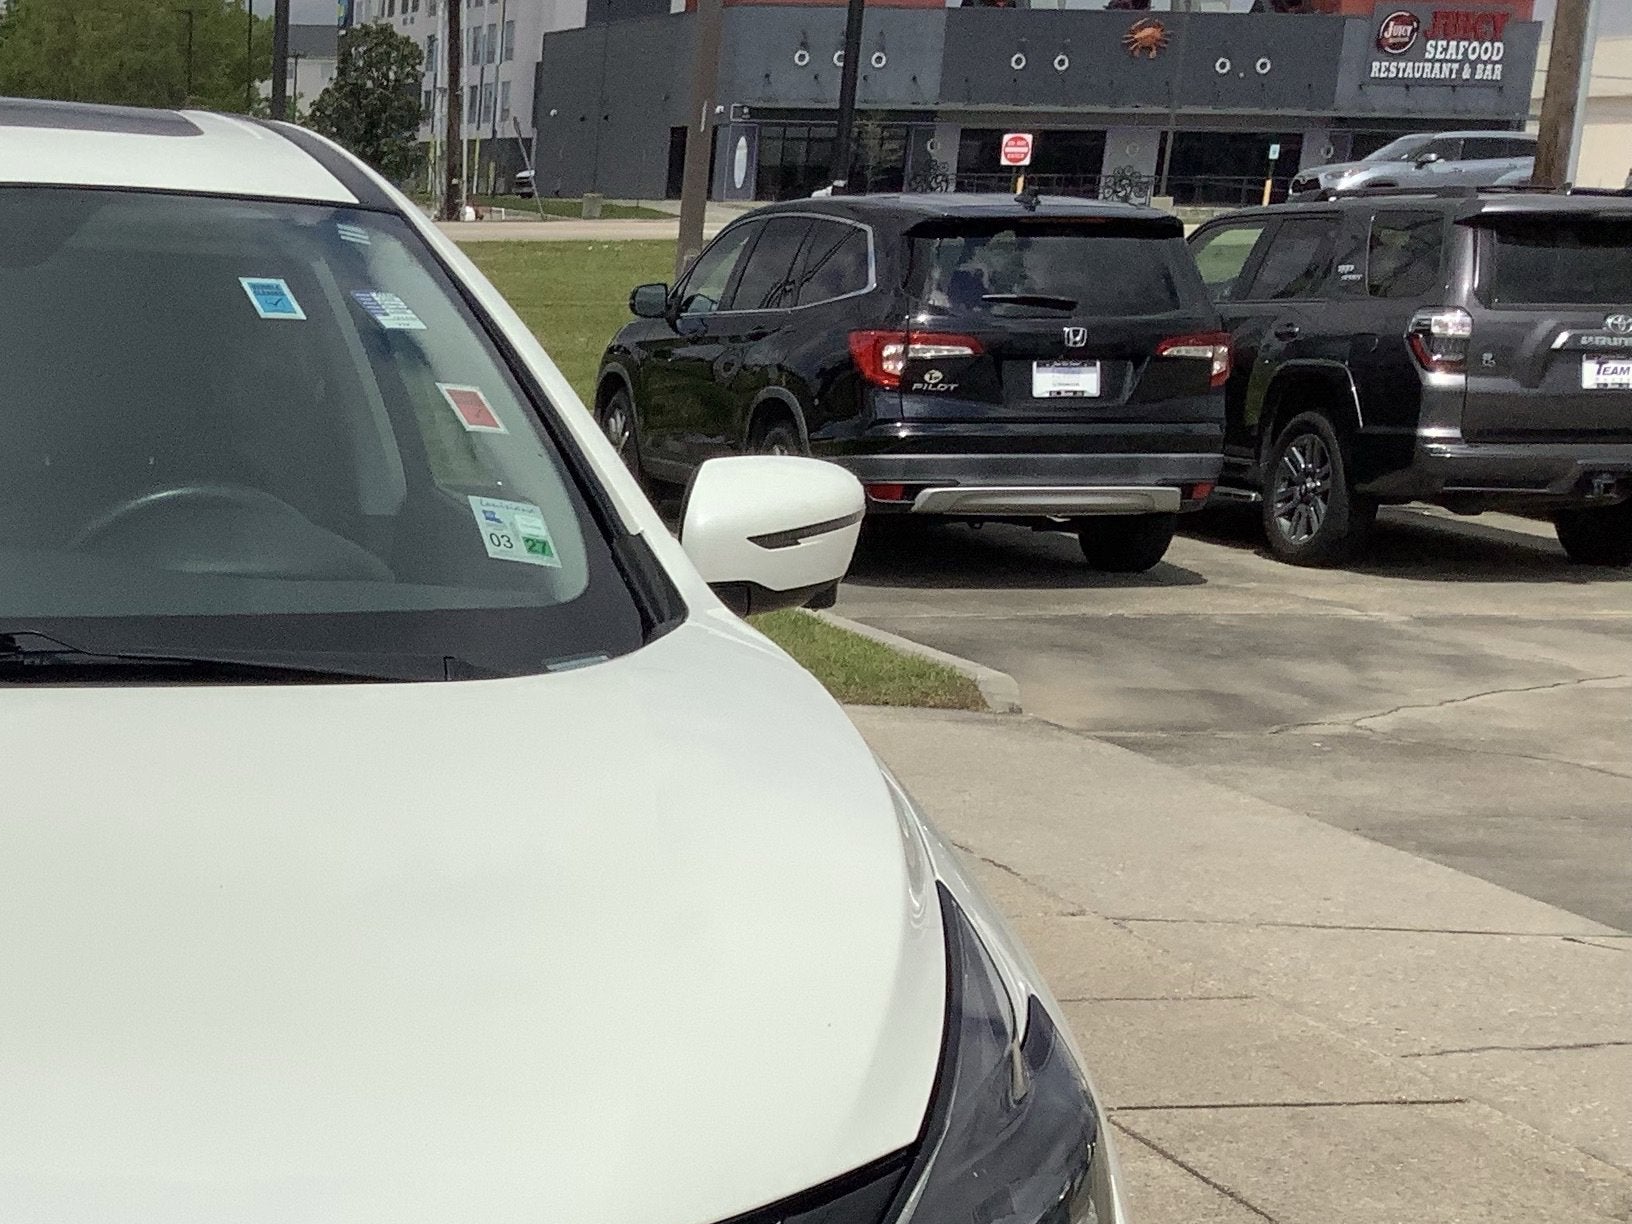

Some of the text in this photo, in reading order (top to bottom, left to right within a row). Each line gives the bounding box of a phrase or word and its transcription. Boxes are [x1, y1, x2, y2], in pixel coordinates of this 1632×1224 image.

[1424, 11, 1510, 39] JUICY
[1425, 40, 1504, 61] SEAFOOD
[1370, 61, 1503, 80] RESTAURANT & BAR
[1595, 357, 1631, 376] TEAM
[912, 383, 959, 392] PILOT
[489, 532, 514, 549] 03
[524, 537, 548, 554] 27
